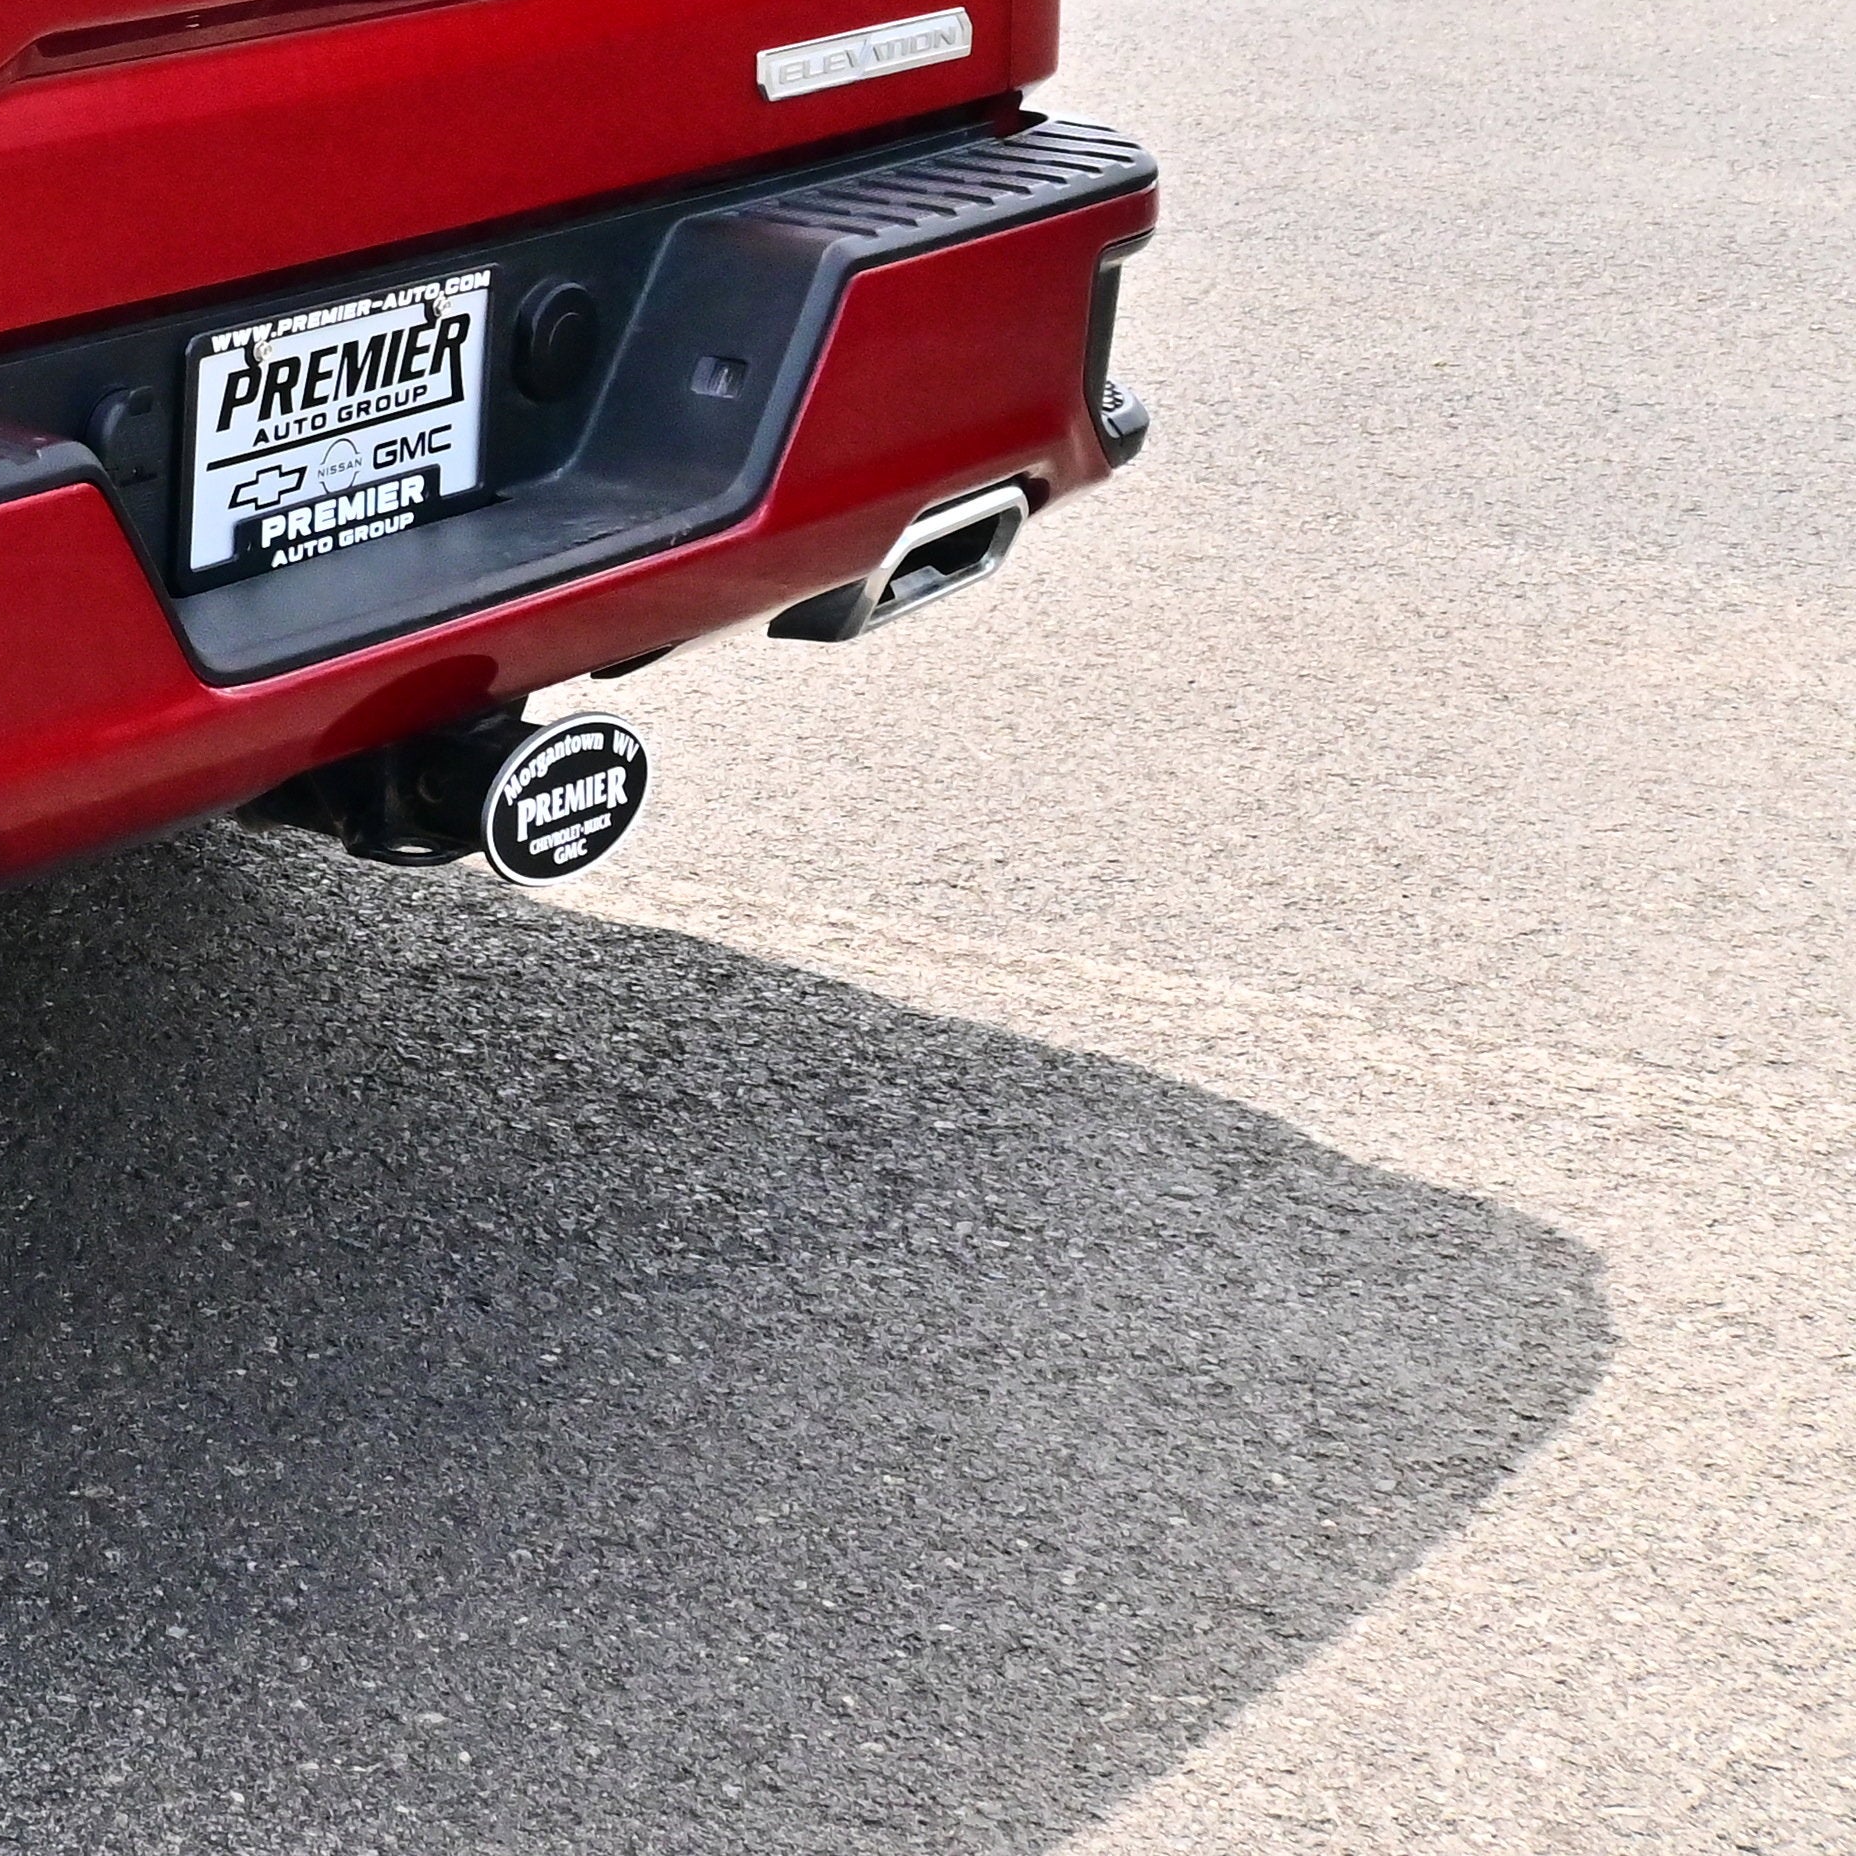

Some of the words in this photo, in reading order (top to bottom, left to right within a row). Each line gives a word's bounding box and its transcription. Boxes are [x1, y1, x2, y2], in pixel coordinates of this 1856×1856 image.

[777, 25, 957, 86] ELEVATION
[211, 269, 492, 353] WWW.PREMIER-AUTO.COM
[216, 312, 472, 433] PREMIER
[252, 412, 327, 447] AUTO
[337, 384, 428, 423] GROUP
[372, 423, 453, 470] GMC
[317, 457, 363, 479] NISSAN
[260, 474, 426, 549] PREMIER
[271, 535, 334, 568] AUTO
[338, 511, 415, 548] GROUP
[502, 731, 605, 806] Morgantown
[611, 729, 639, 763] WV
[517, 765, 628, 843] PREMIER
[553, 837, 588, 865] GMC
